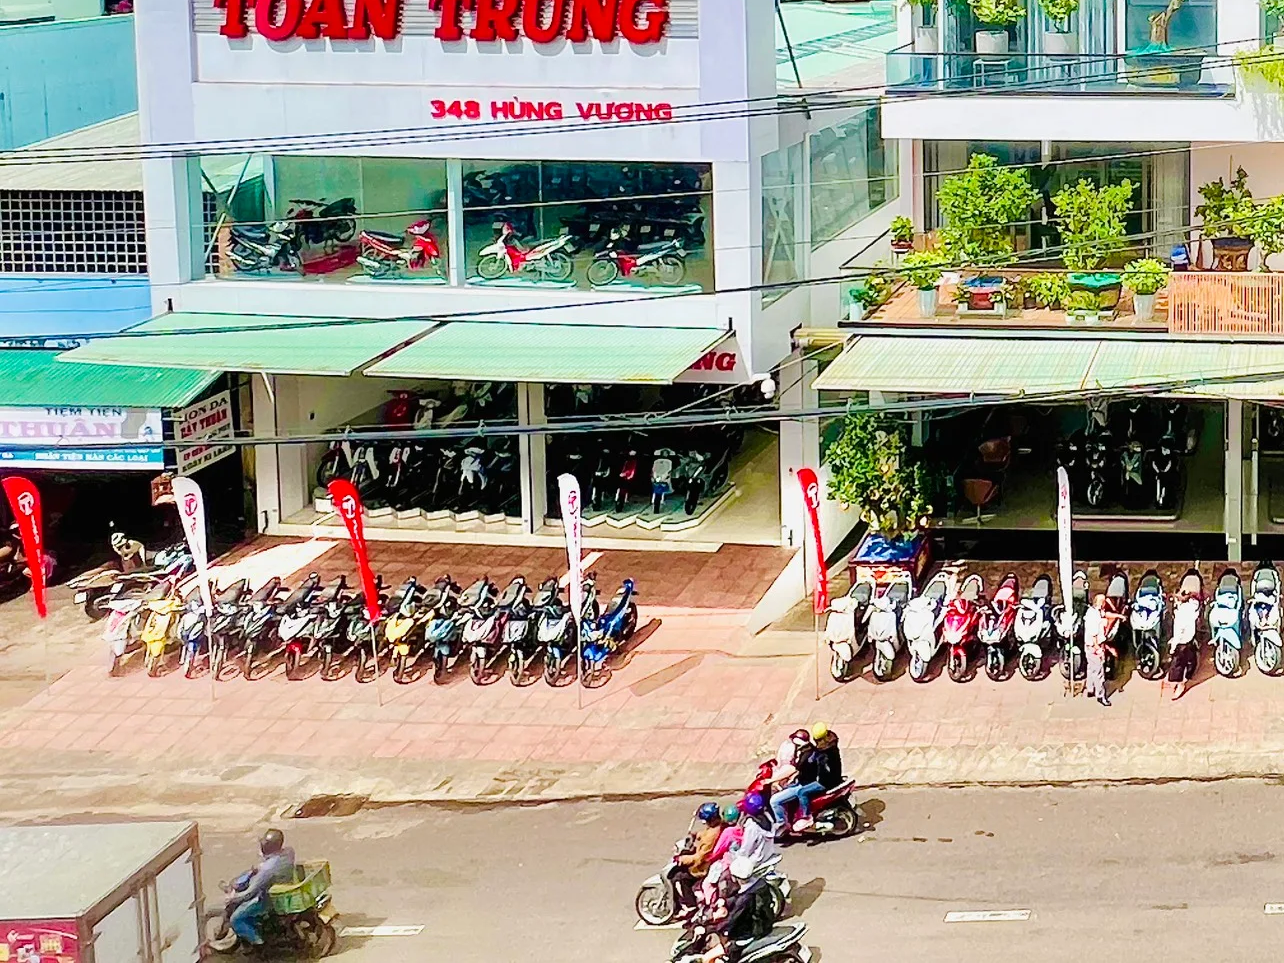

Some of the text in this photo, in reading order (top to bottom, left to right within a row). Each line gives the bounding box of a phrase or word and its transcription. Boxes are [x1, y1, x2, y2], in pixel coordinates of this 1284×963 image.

[430, 96, 673, 123] 348 HÙNG VƯƠNG
